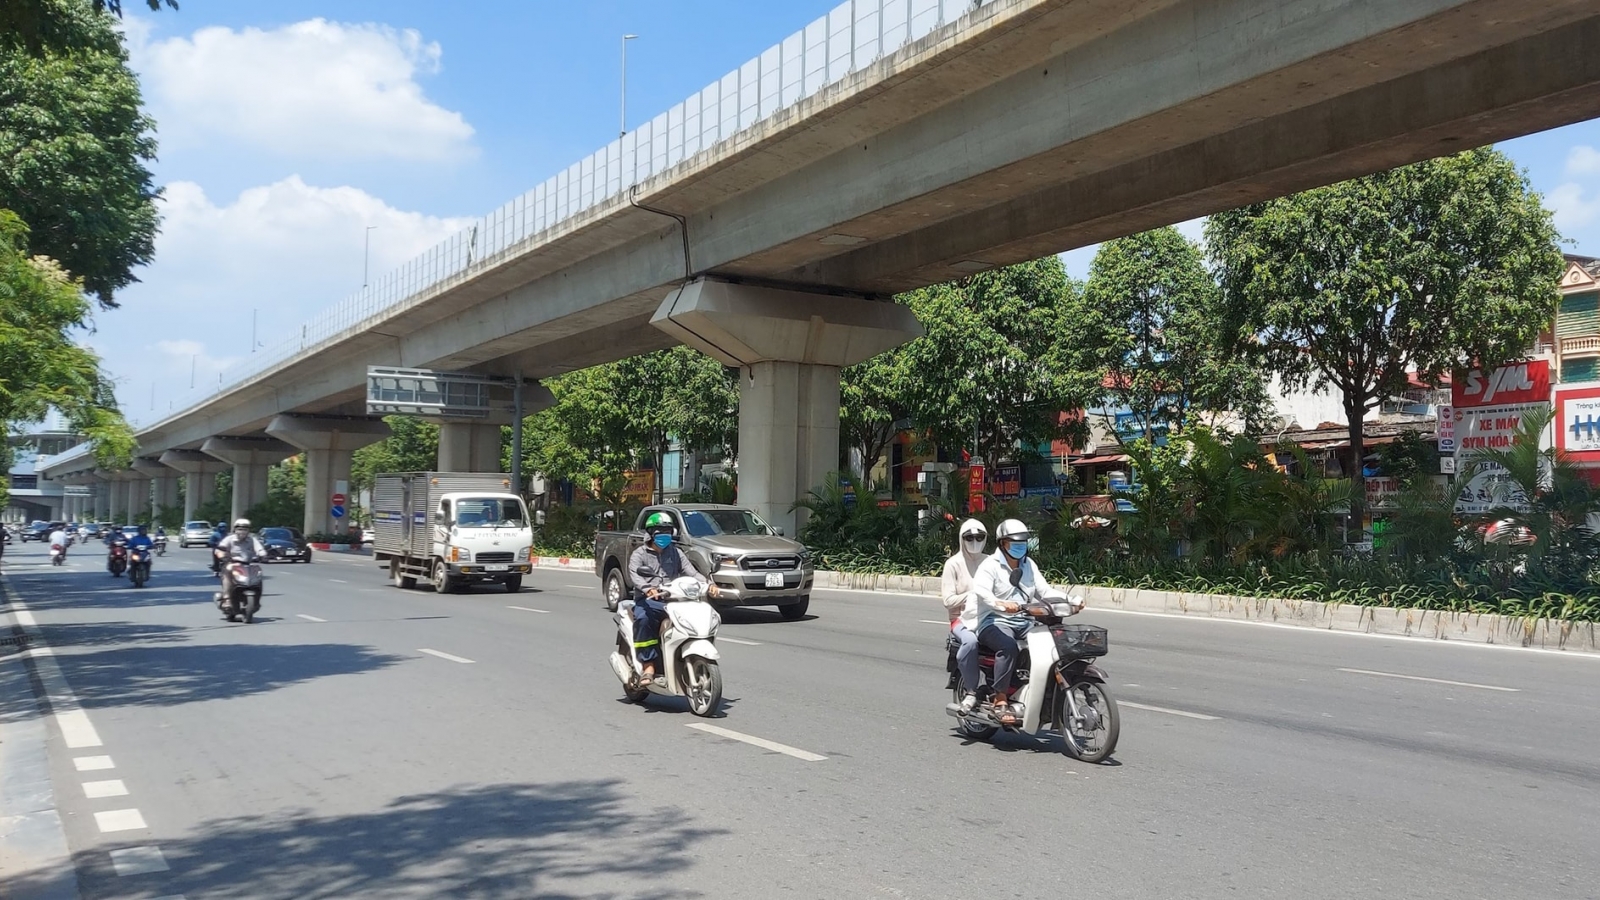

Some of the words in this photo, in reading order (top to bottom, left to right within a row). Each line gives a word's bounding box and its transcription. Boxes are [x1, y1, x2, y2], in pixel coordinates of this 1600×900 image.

[1464, 364, 1534, 402] SYM
[1480, 419, 1492, 431] XE
[1496, 415, 1519, 430] MÁY
[1462, 437, 1486, 449] SYM
